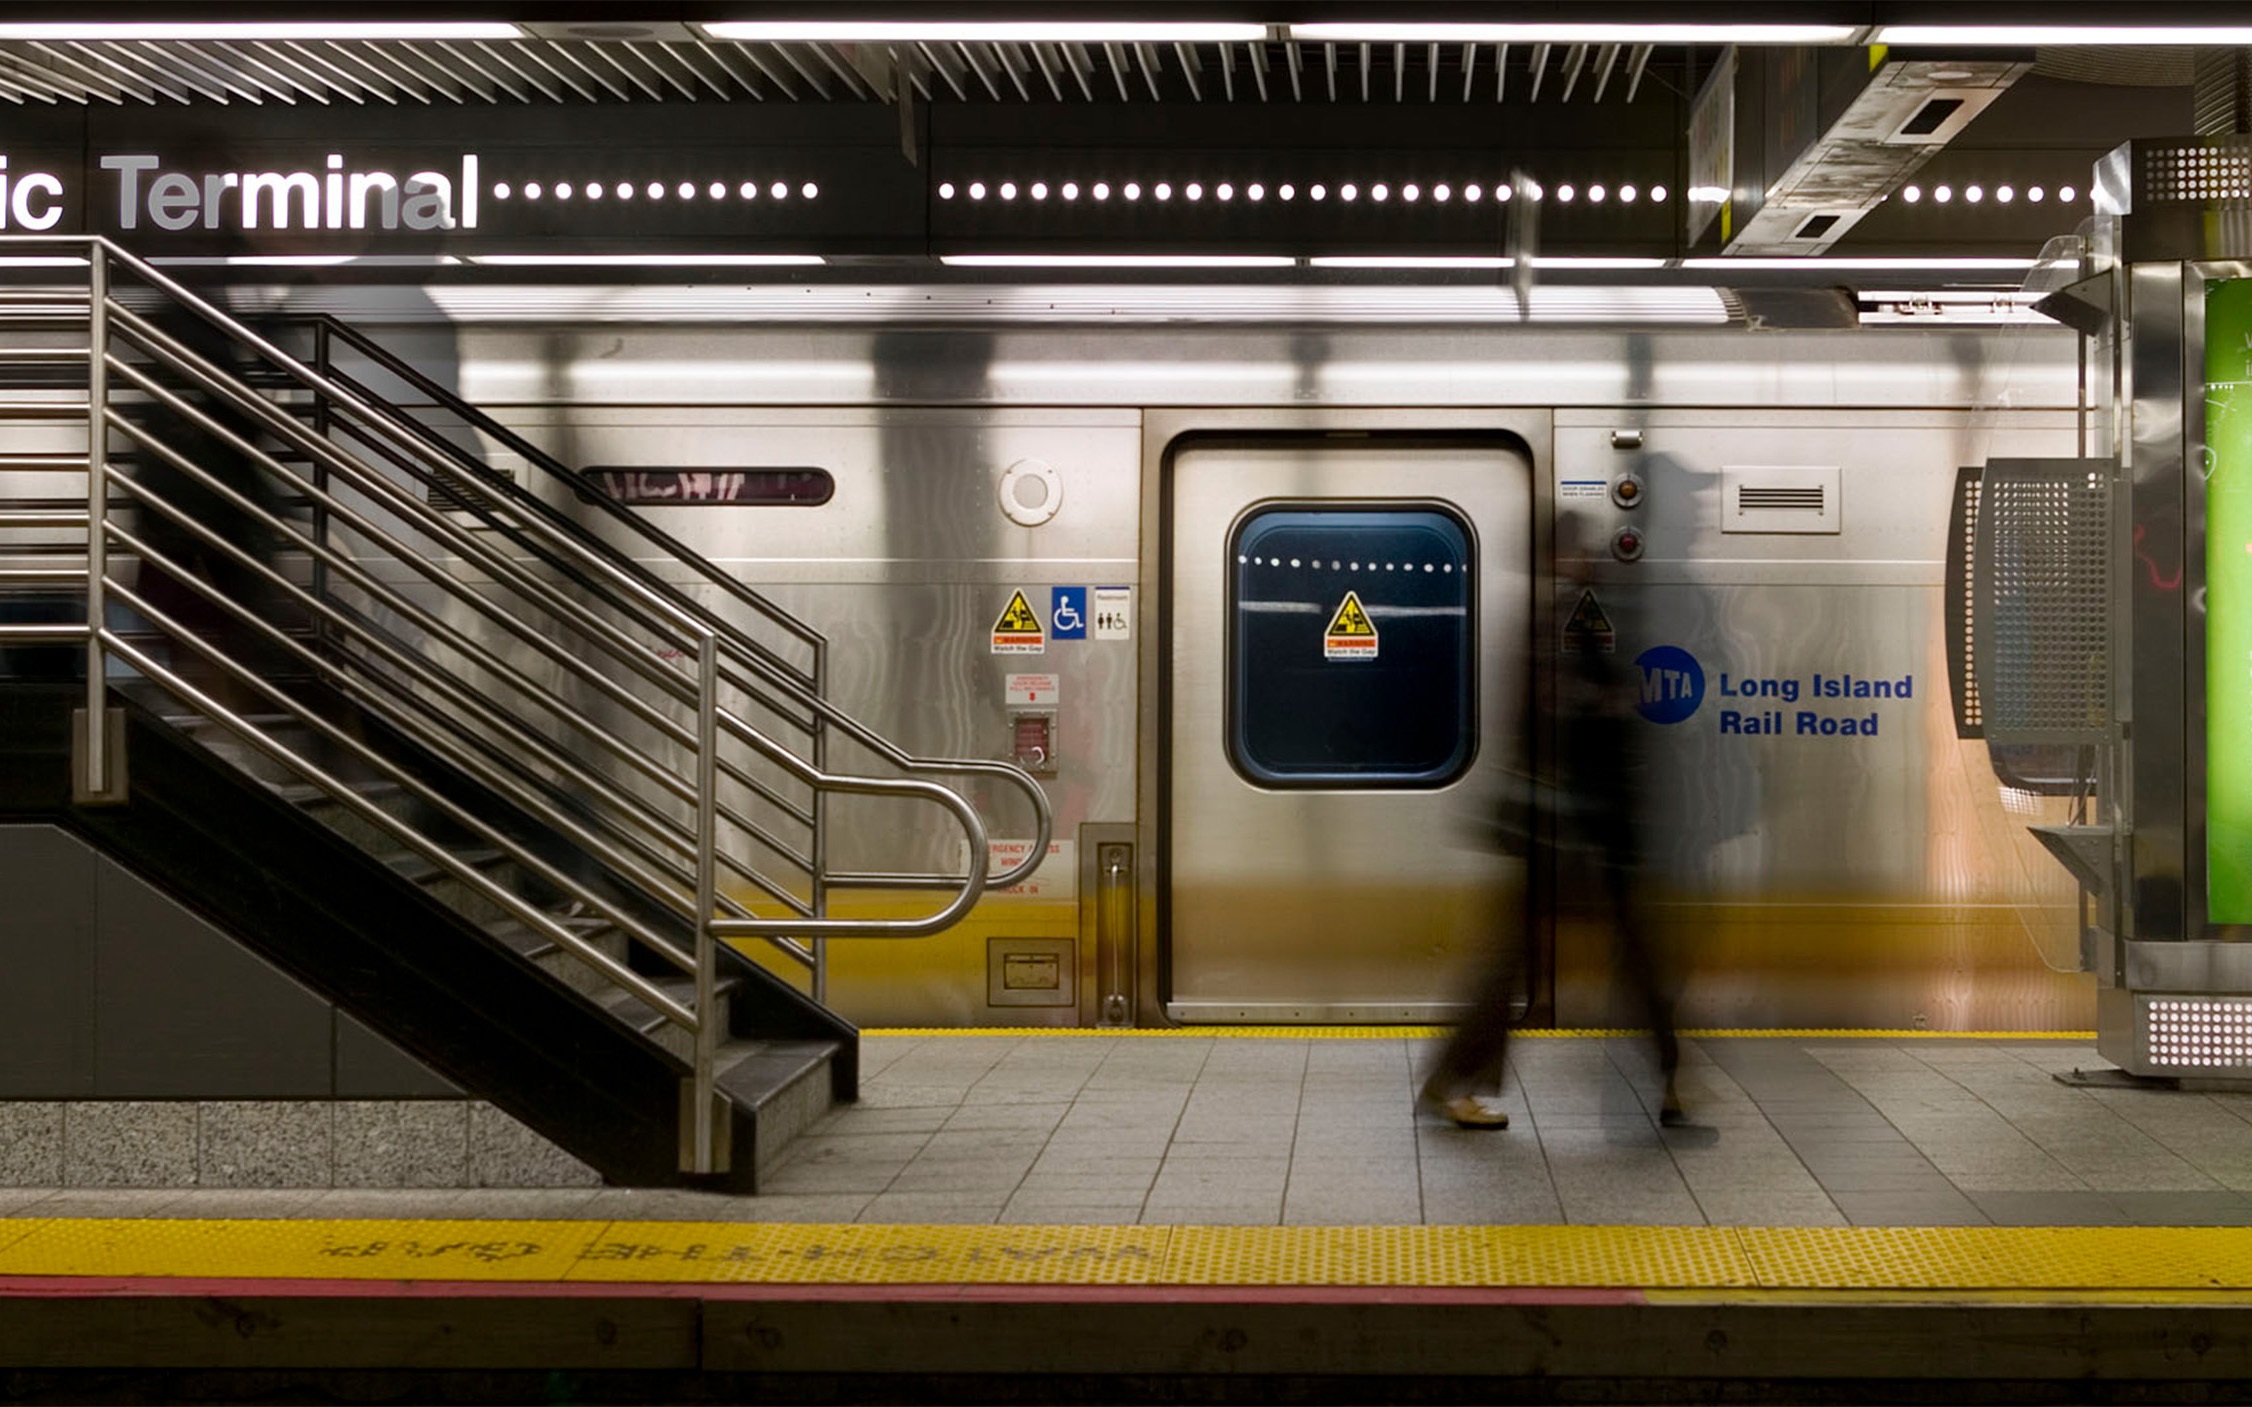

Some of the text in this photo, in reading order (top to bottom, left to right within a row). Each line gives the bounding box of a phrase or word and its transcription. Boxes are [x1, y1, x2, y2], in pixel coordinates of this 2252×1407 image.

[100, 153, 479, 231] Terminal
[1028, 645, 1042, 653] Gap
[1361, 648, 1376, 656] Gap
[1638, 665, 1693, 703] MTA
[1720, 673, 1913, 703] Long Island
[1720, 711, 1879, 736] Rail Road
